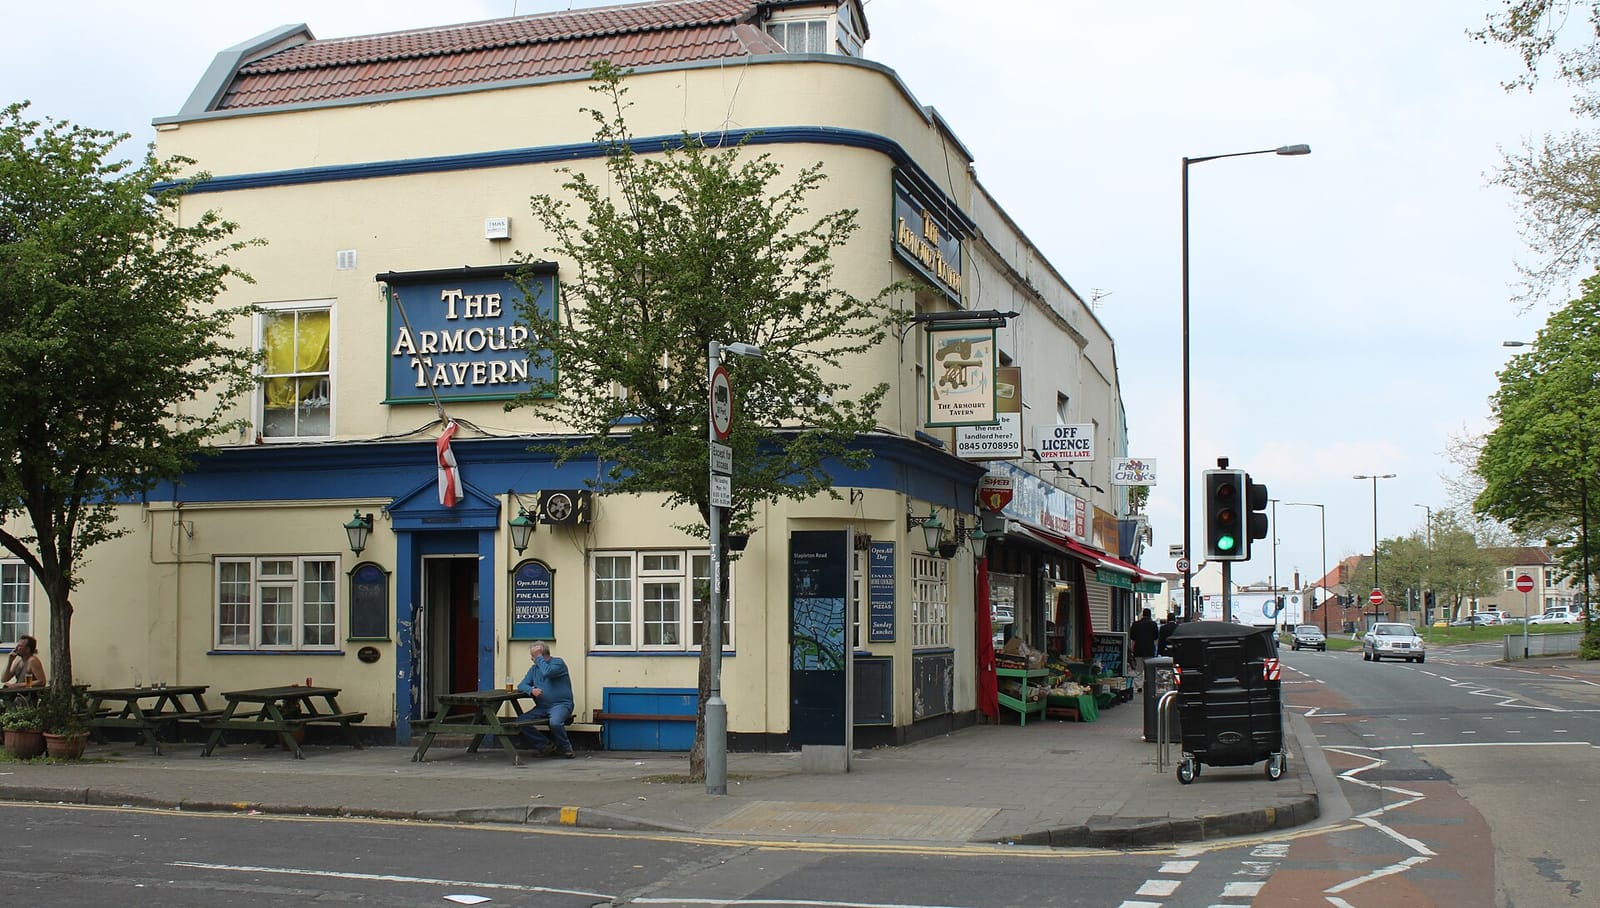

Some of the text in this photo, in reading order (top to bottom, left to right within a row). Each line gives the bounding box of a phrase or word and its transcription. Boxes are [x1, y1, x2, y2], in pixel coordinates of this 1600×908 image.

[441, 289, 502, 319] THE
[411, 357, 529, 388] TAVERN
[995, 432, 1013, 440] here?
[1054, 427, 1078, 438] OFF
[958, 441, 1019, 450] 0845 0708950
[1042, 438, 1090, 451] LICENCE
[871, 547, 884, 555] Open
[1178, 561, 1188, 569] 20
[516, 605, 550, 614] HOME COOKED
[872, 621, 892, 629] Sunday
